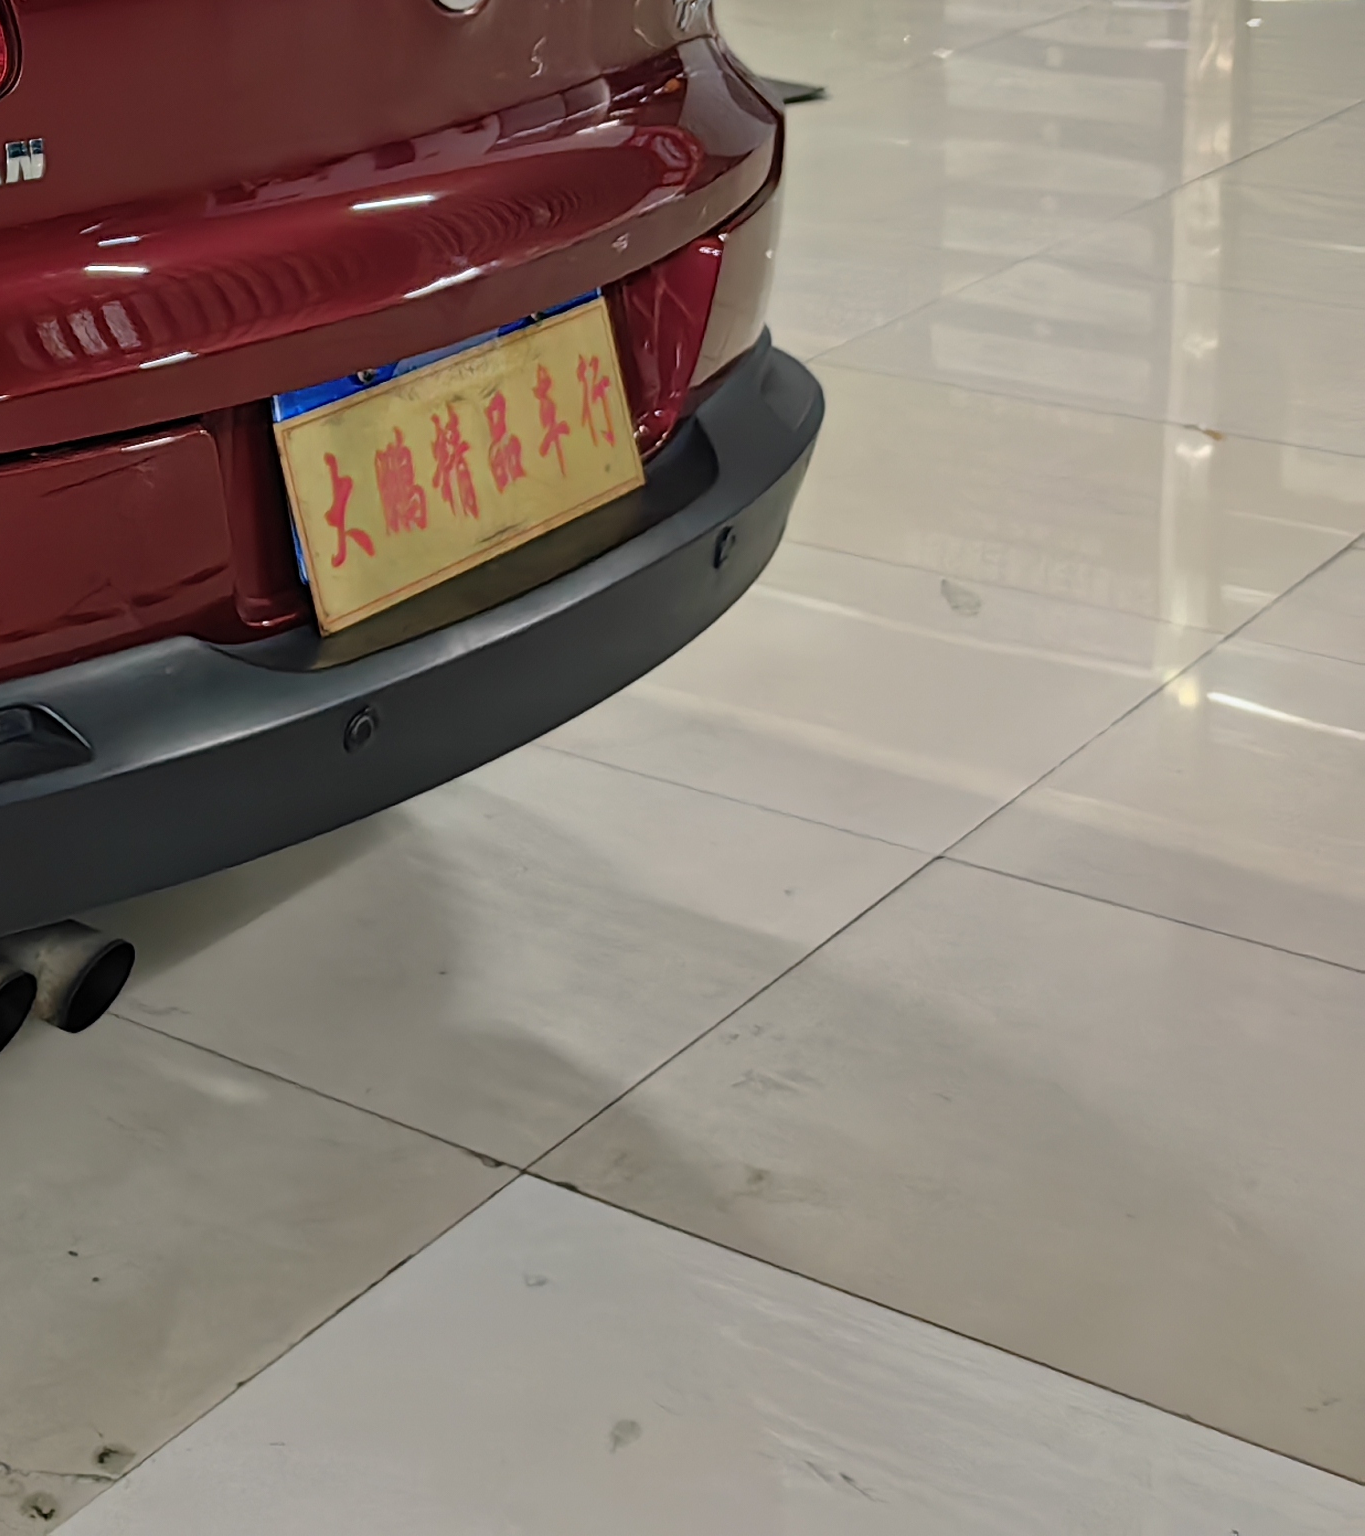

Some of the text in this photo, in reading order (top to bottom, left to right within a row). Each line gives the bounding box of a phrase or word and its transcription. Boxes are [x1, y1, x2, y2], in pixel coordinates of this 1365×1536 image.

[324, 354, 616, 568] 大鹏精品车行
